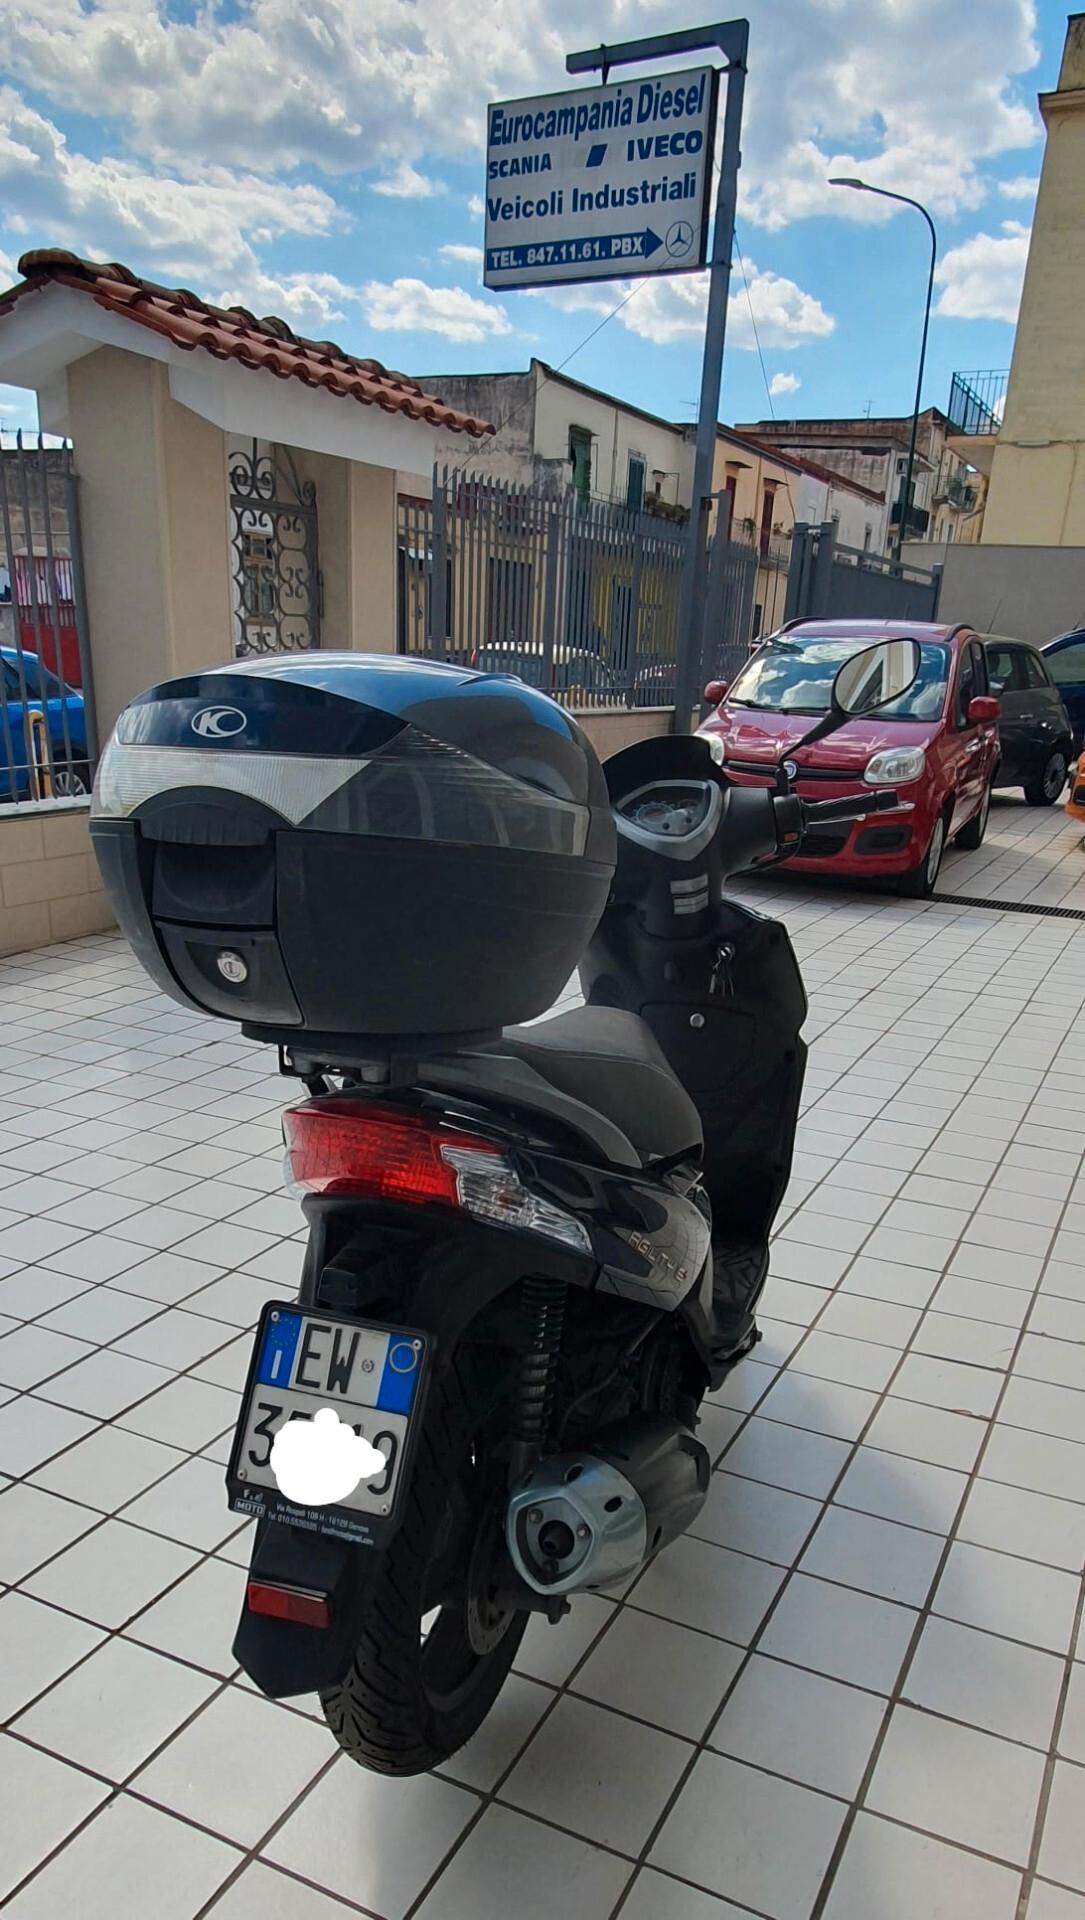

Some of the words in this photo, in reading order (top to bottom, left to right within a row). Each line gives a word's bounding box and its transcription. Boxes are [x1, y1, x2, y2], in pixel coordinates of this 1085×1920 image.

[489, 89, 633, 146] Eurocampania
[636, 73, 706, 124] Diesel
[627, 130, 703, 162] IVECO
[488, 152, 552, 179] SCANIA
[487, 190, 563, 222] Veicoli
[572, 172, 696, 212] Industriali
[491, 250, 523, 268] TEL.
[611, 236, 643, 256] PBX
[295, 1322, 361, 1394] EW
[237, 1501, 264, 1514] MOTO
